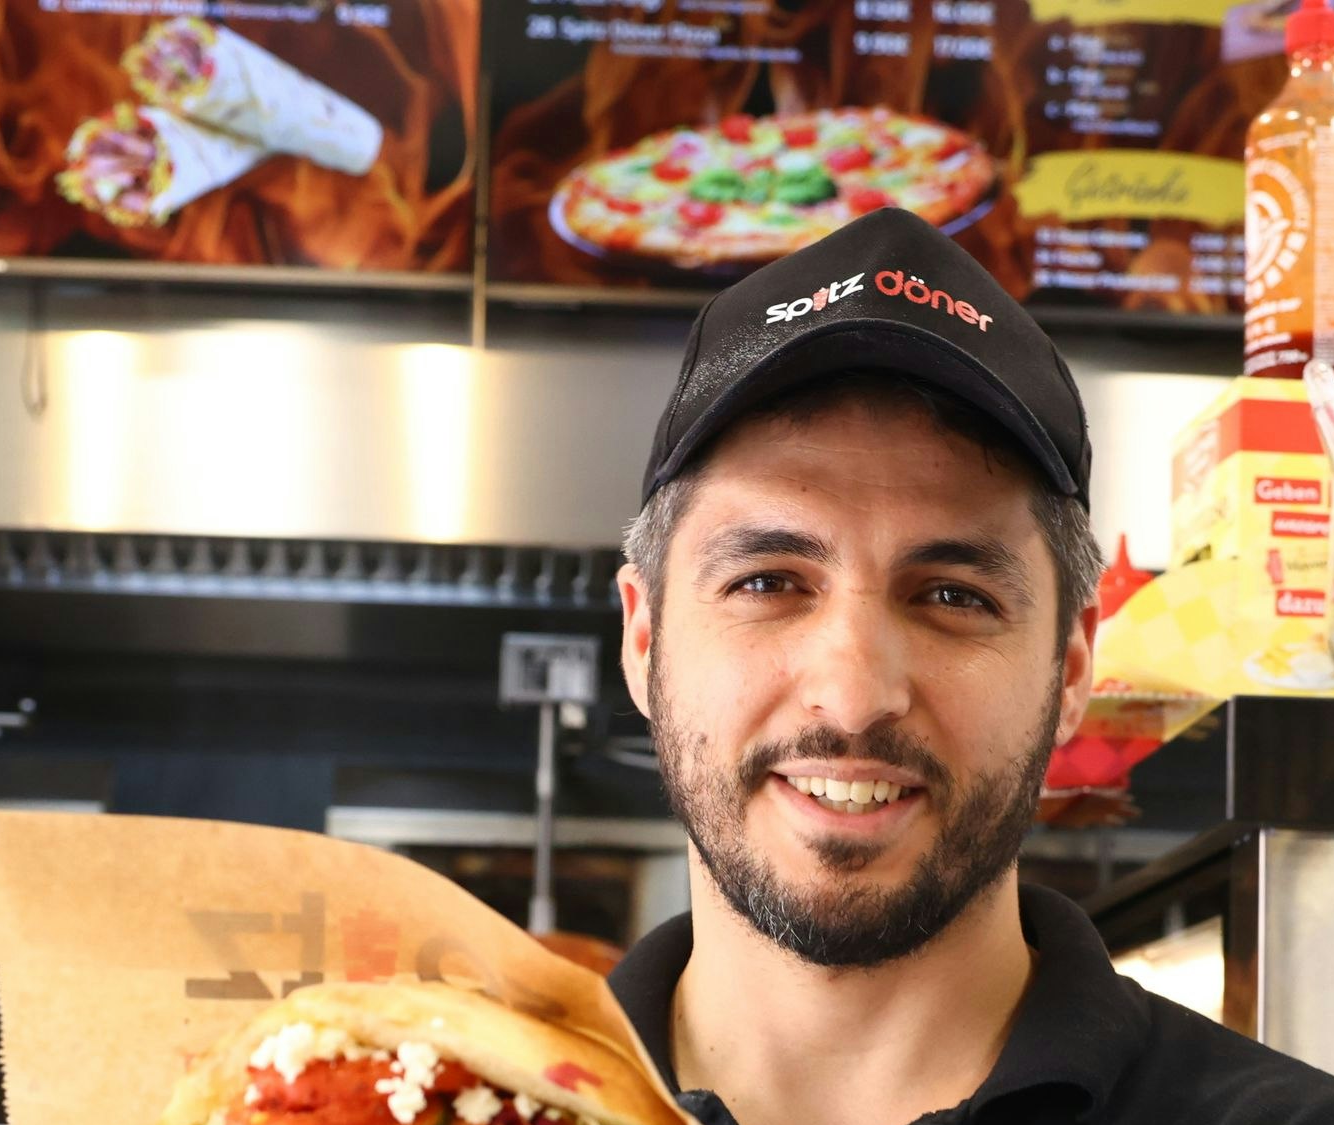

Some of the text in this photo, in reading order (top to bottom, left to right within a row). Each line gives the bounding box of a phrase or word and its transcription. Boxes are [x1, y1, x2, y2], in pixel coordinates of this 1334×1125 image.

[766, 269, 994, 332] spitz döner
[1256, 479, 1319, 501] Geben
